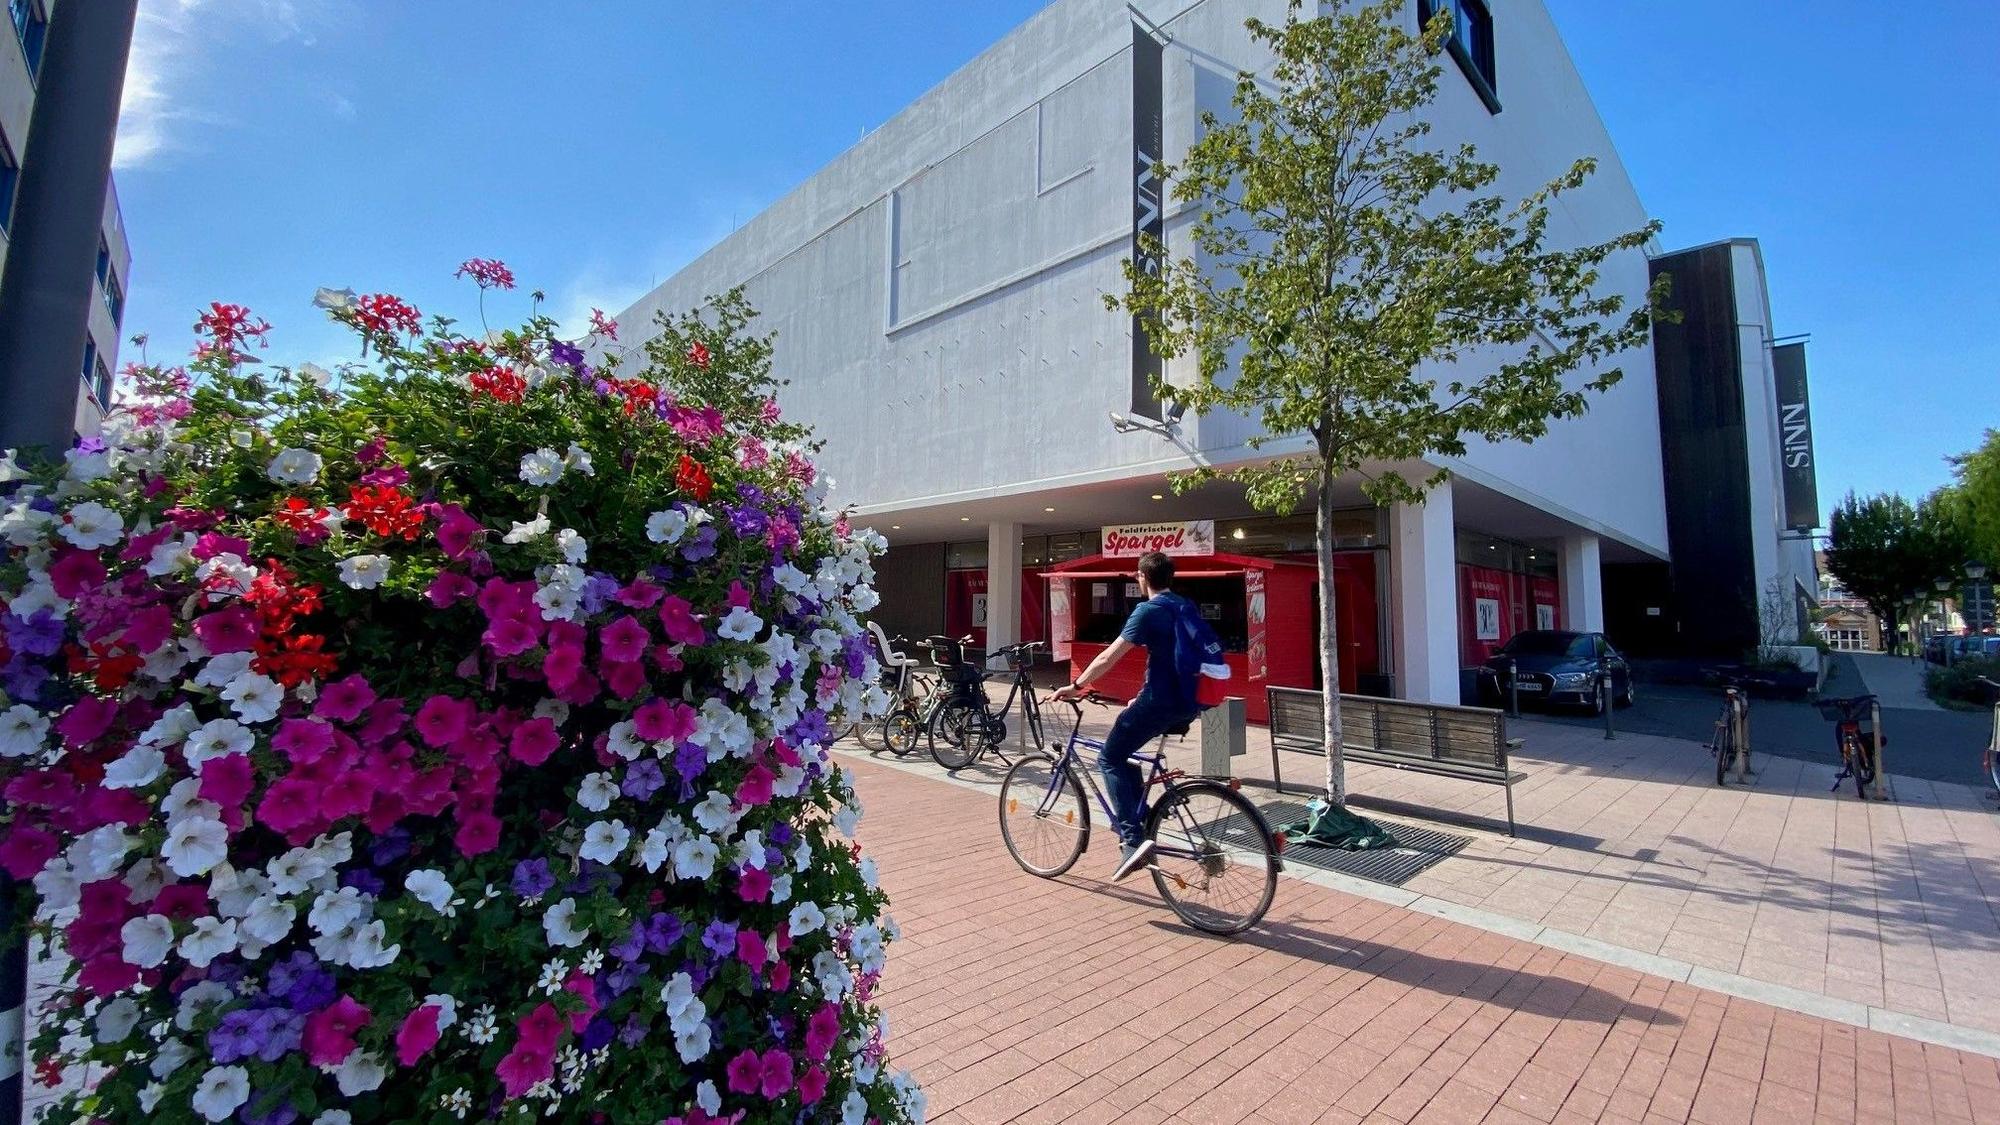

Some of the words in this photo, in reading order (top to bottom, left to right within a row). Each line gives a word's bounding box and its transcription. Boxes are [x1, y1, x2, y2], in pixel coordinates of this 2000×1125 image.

[1782, 403, 1810, 469] SiNN
[1105, 528, 1185, 555] Spargel
[1120, 526, 1178, 534] Feldfrischer
